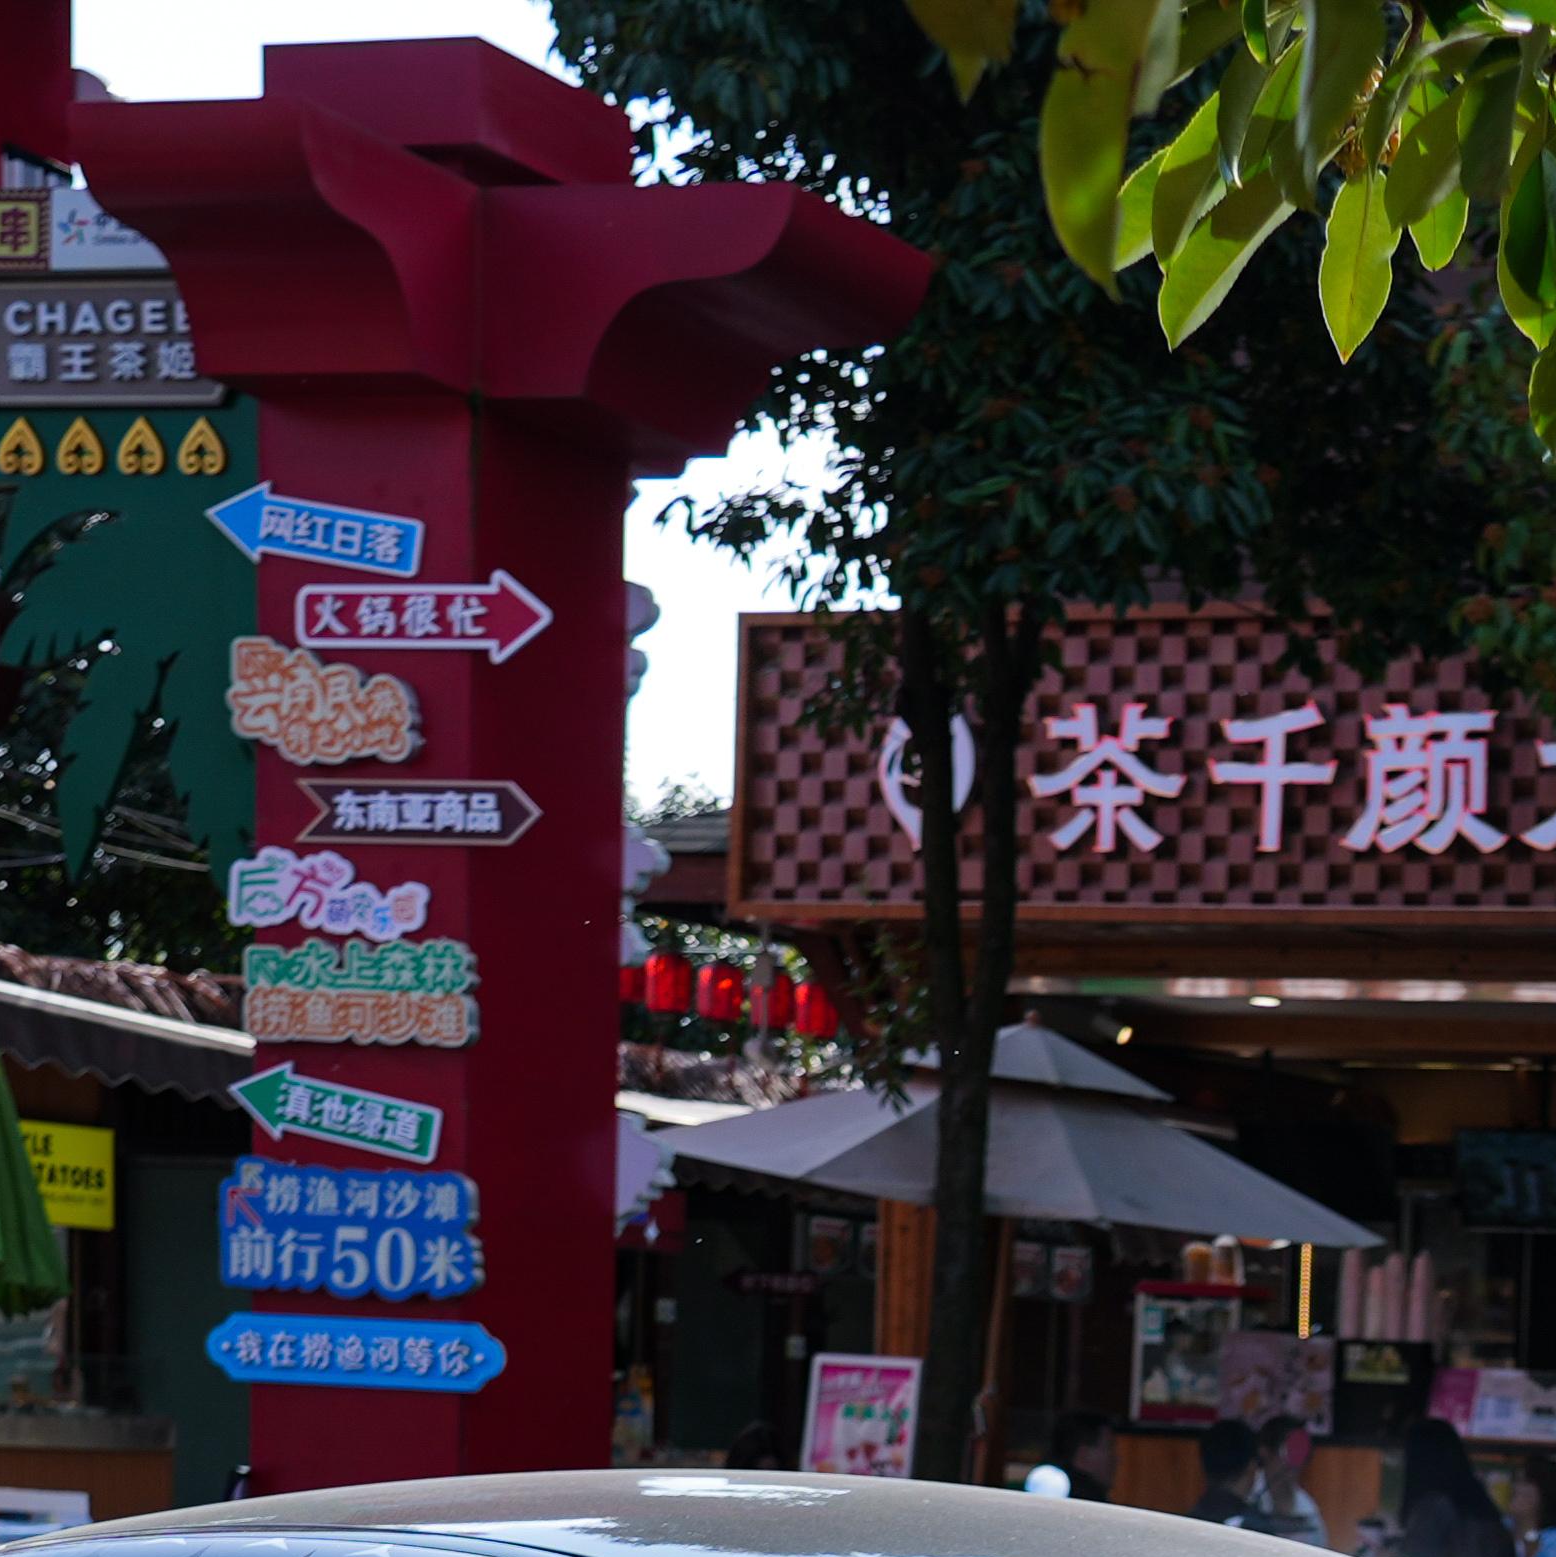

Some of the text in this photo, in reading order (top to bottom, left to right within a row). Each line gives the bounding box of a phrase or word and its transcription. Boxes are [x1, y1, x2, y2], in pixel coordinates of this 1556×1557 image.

[257, 503, 405, 566] 网红日落
[310, 593, 490, 639] 火锅很忙
[331, 788, 504, 834] 东南亚商品
[291, 938, 468, 993] 水上森林
[275, 1084, 423, 1152] 滇池绿道
[263, 1170, 462, 1224] 捞渔河沙滩
[227, 1222, 467, 1292] 前行50米
